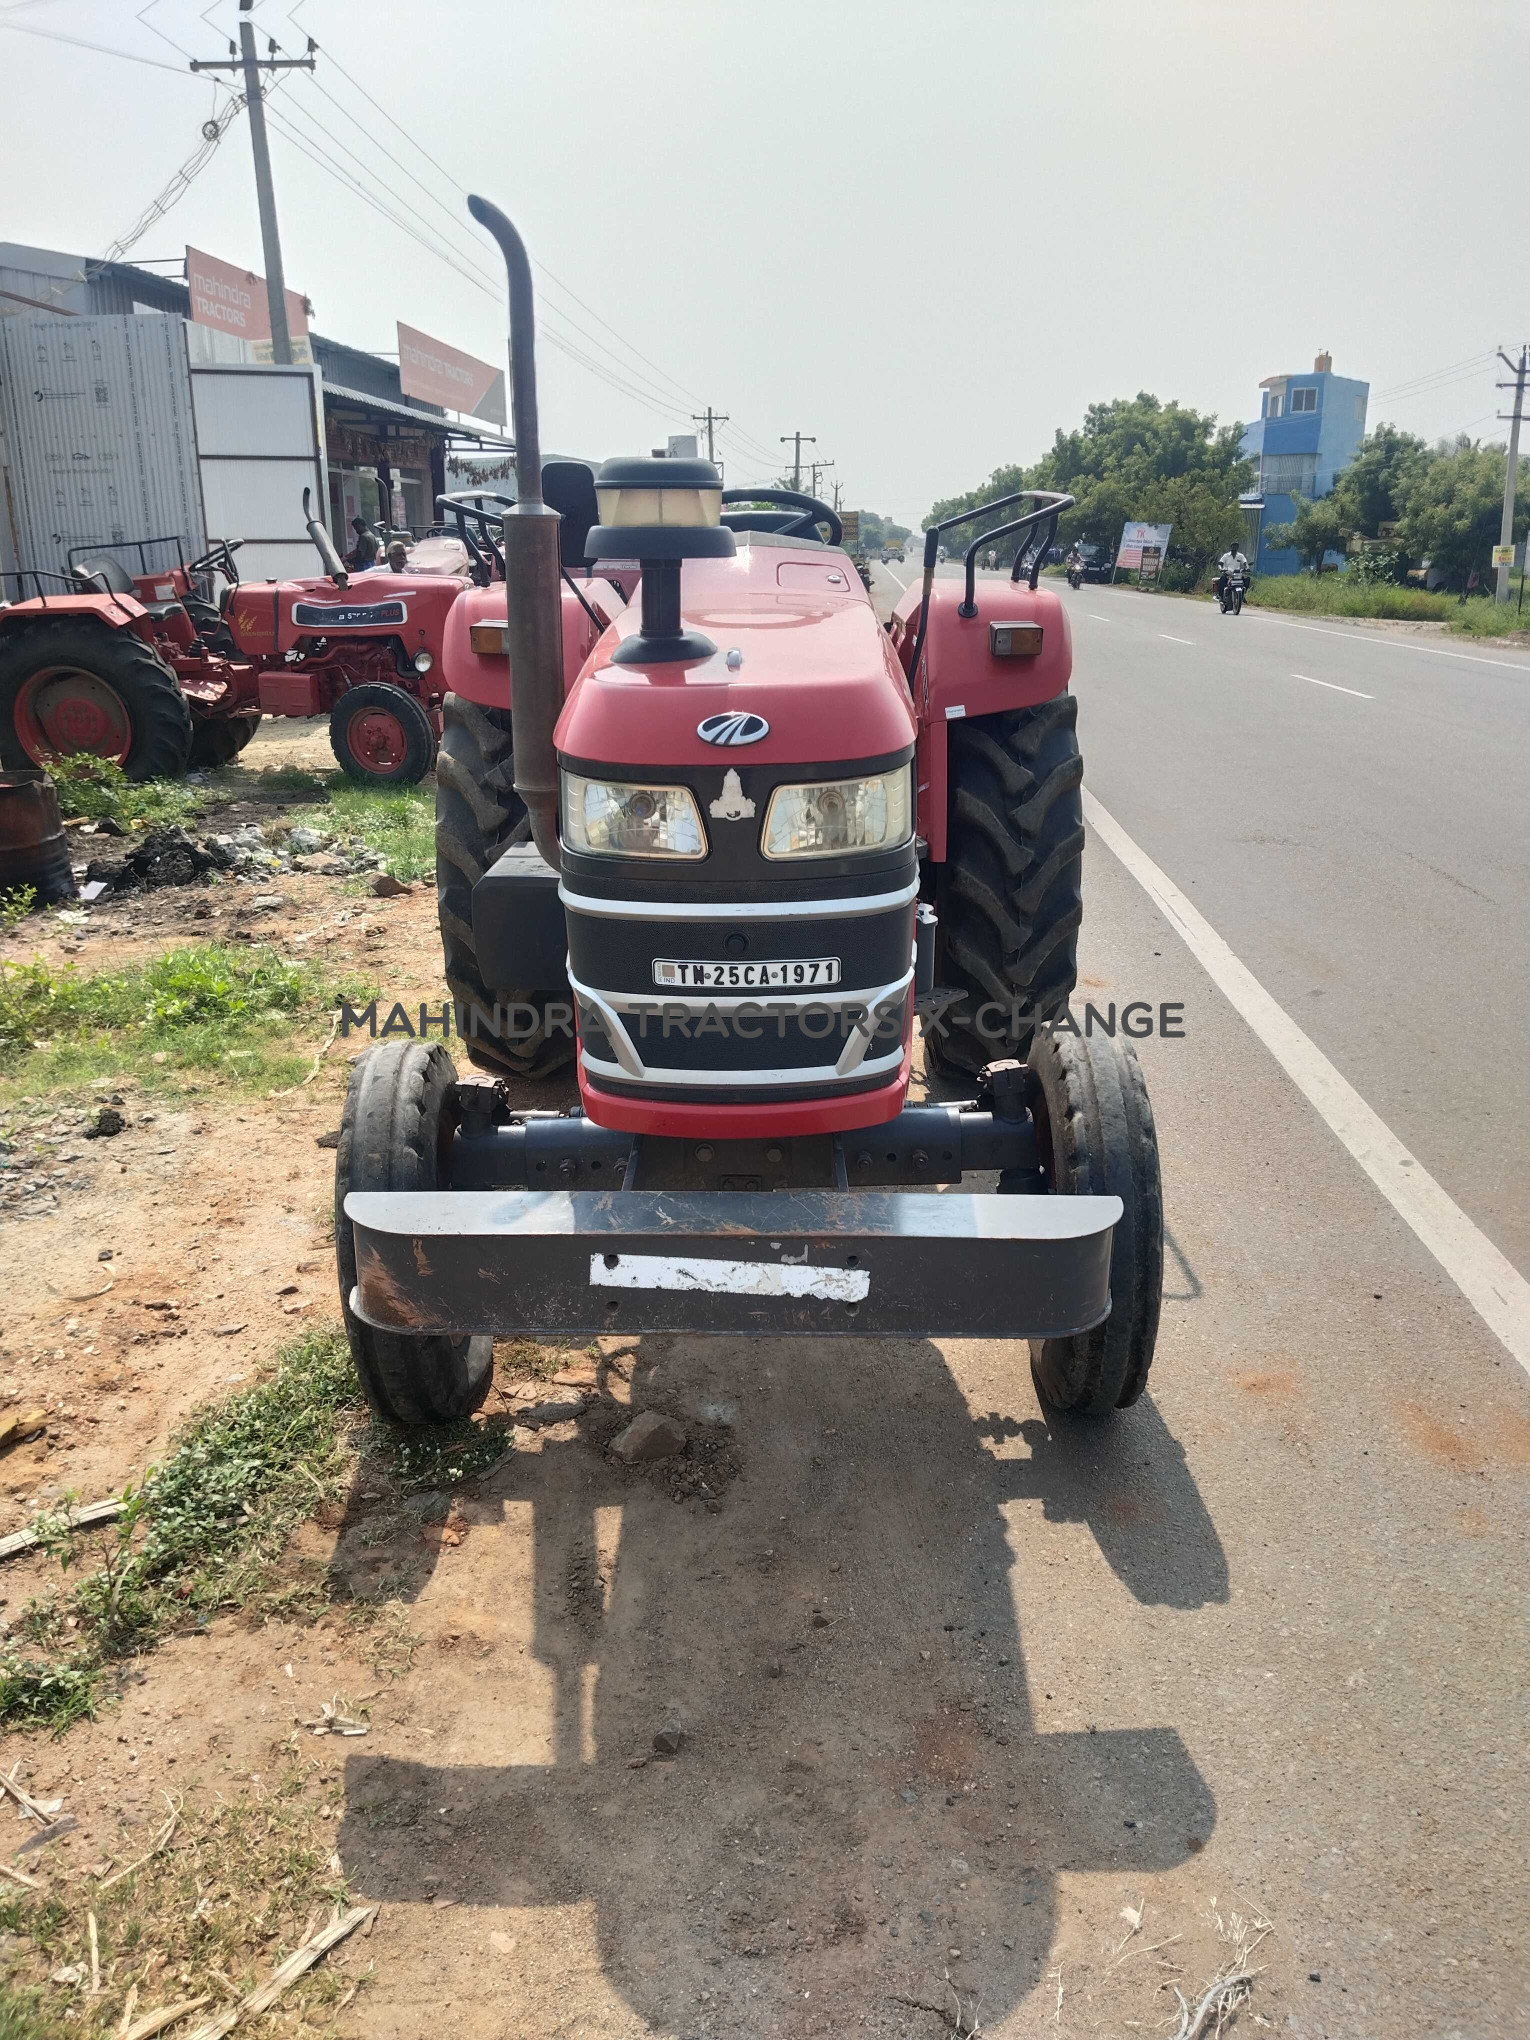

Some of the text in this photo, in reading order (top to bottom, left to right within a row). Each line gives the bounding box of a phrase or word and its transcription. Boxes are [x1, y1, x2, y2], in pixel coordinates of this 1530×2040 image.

[193, 272, 251, 309] mahindra
[195, 295, 246, 328] TRACTORS
[380, 608, 400, 617] PLUS
[677, 965, 705, 985] TN
[713, 966, 770, 986] 25CA
[780, 962, 834, 984] 1971
